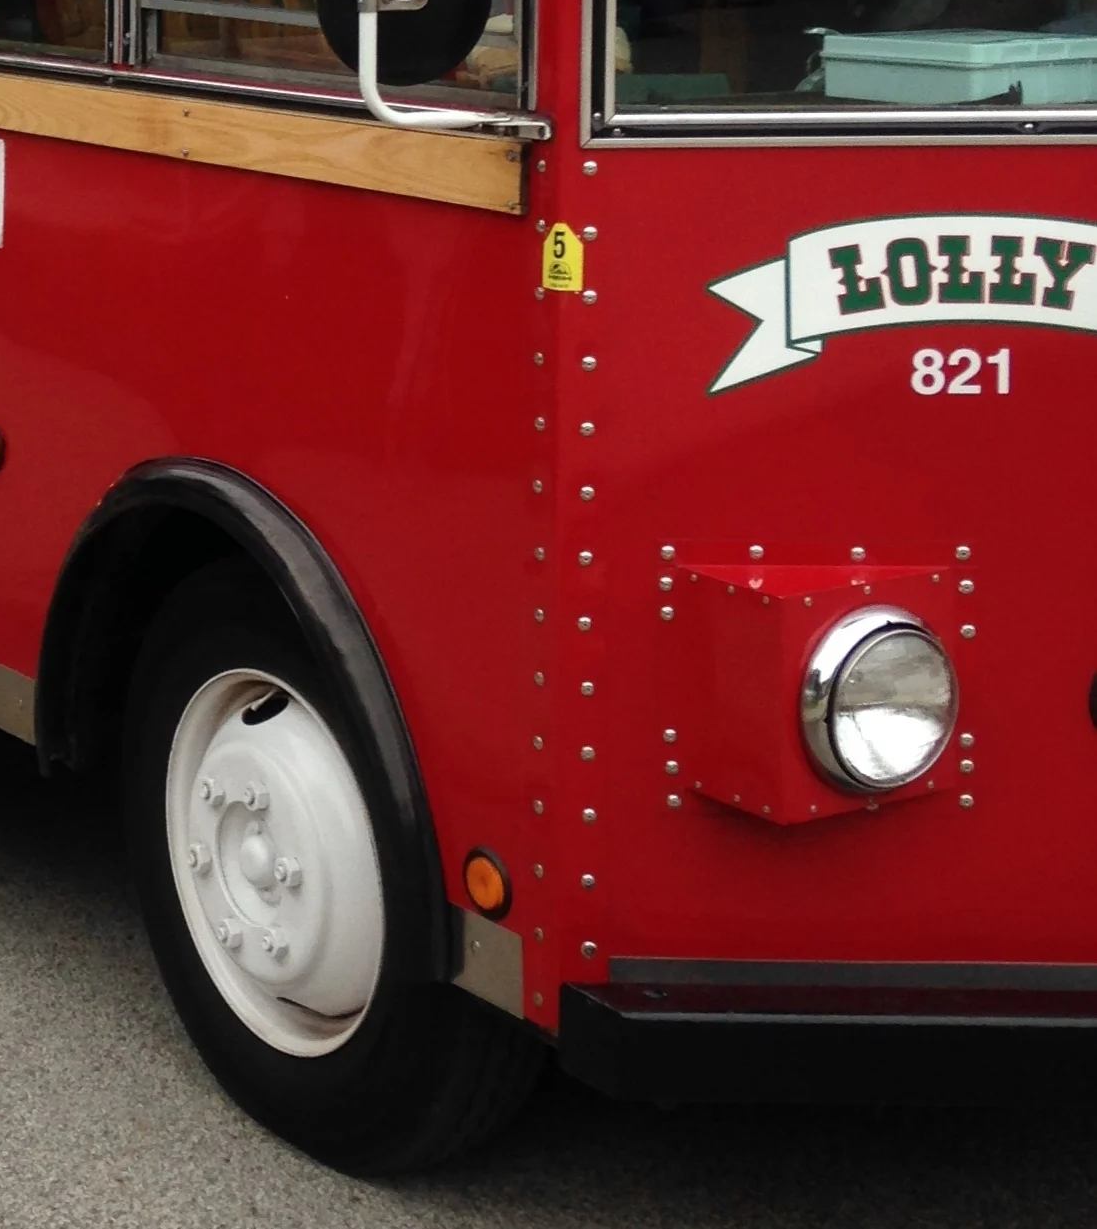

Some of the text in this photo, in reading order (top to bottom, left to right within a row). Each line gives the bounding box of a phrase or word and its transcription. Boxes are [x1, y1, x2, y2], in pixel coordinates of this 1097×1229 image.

[553, 231, 566, 259] 5
[828, 234, 1096, 315] LOLLY
[910, 348, 1012, 396] 821
